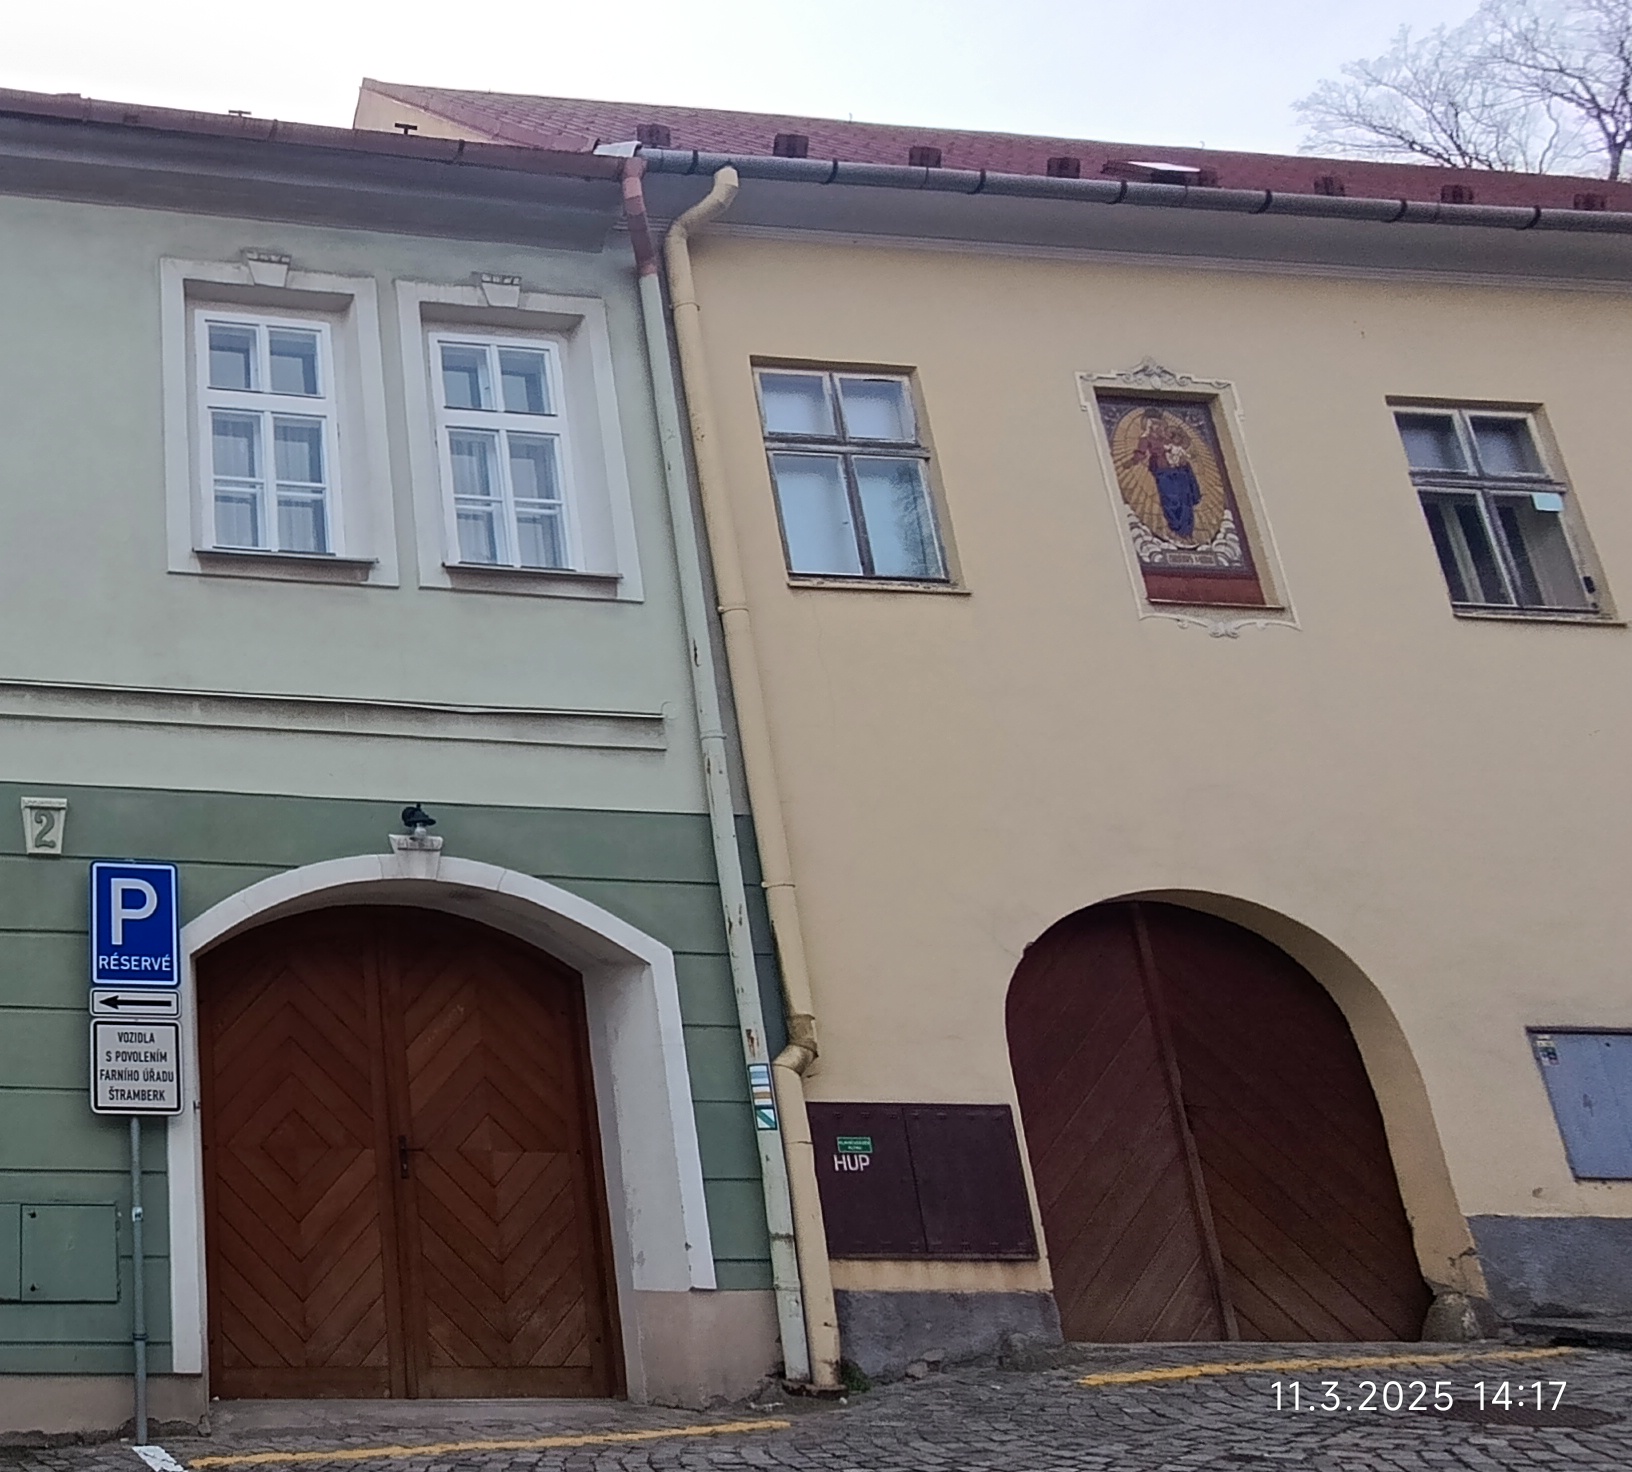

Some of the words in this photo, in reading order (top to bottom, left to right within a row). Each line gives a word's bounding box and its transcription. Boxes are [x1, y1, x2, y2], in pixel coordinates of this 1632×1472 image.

[34, 810, 56, 848] 2
[110, 877, 158, 946] P
[98, 952, 171, 972] RÉSERVÉ
[117, 1031, 155, 1044] VOZIDLA
[105, 1050, 112, 1061] S
[114, 1049, 167, 1063] POVOLENÍM
[99, 1067, 140, 1082] FARNÍHO
[142, 1068, 174, 1083] ÚŘADU
[108, 1085, 166, 1102] ŠTRAMBERK
[833, 1154, 870, 1171] HUP
